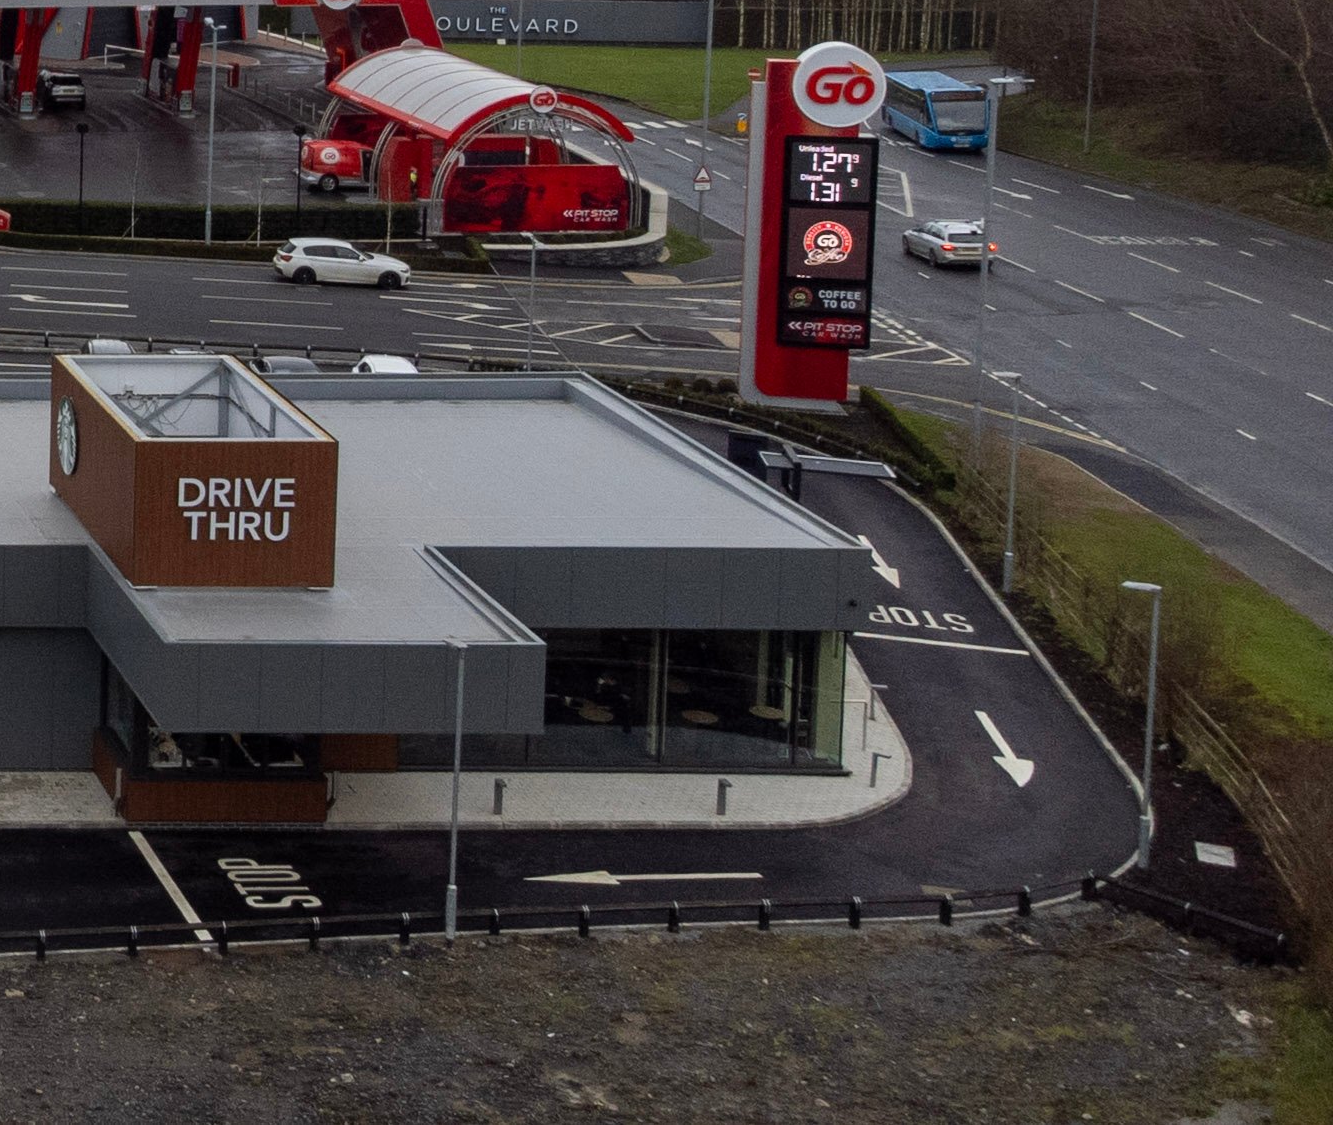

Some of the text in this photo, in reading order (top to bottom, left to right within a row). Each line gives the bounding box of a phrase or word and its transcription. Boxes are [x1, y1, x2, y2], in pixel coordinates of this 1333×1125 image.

[435, 16, 578, 34] OULEVARD
[574, 209, 619, 217] PIT STOP
[818, 290, 862, 301] COFFEE
[822, 299, 838, 309] TO
[840, 301, 856, 309] GO
[803, 321, 863, 332] PIT STOP
[178, 478, 295, 507] DRIVE
[183, 511, 290, 542] THRU
[869, 605, 974, 633] STOP
[218, 858, 322, 907] STOP
